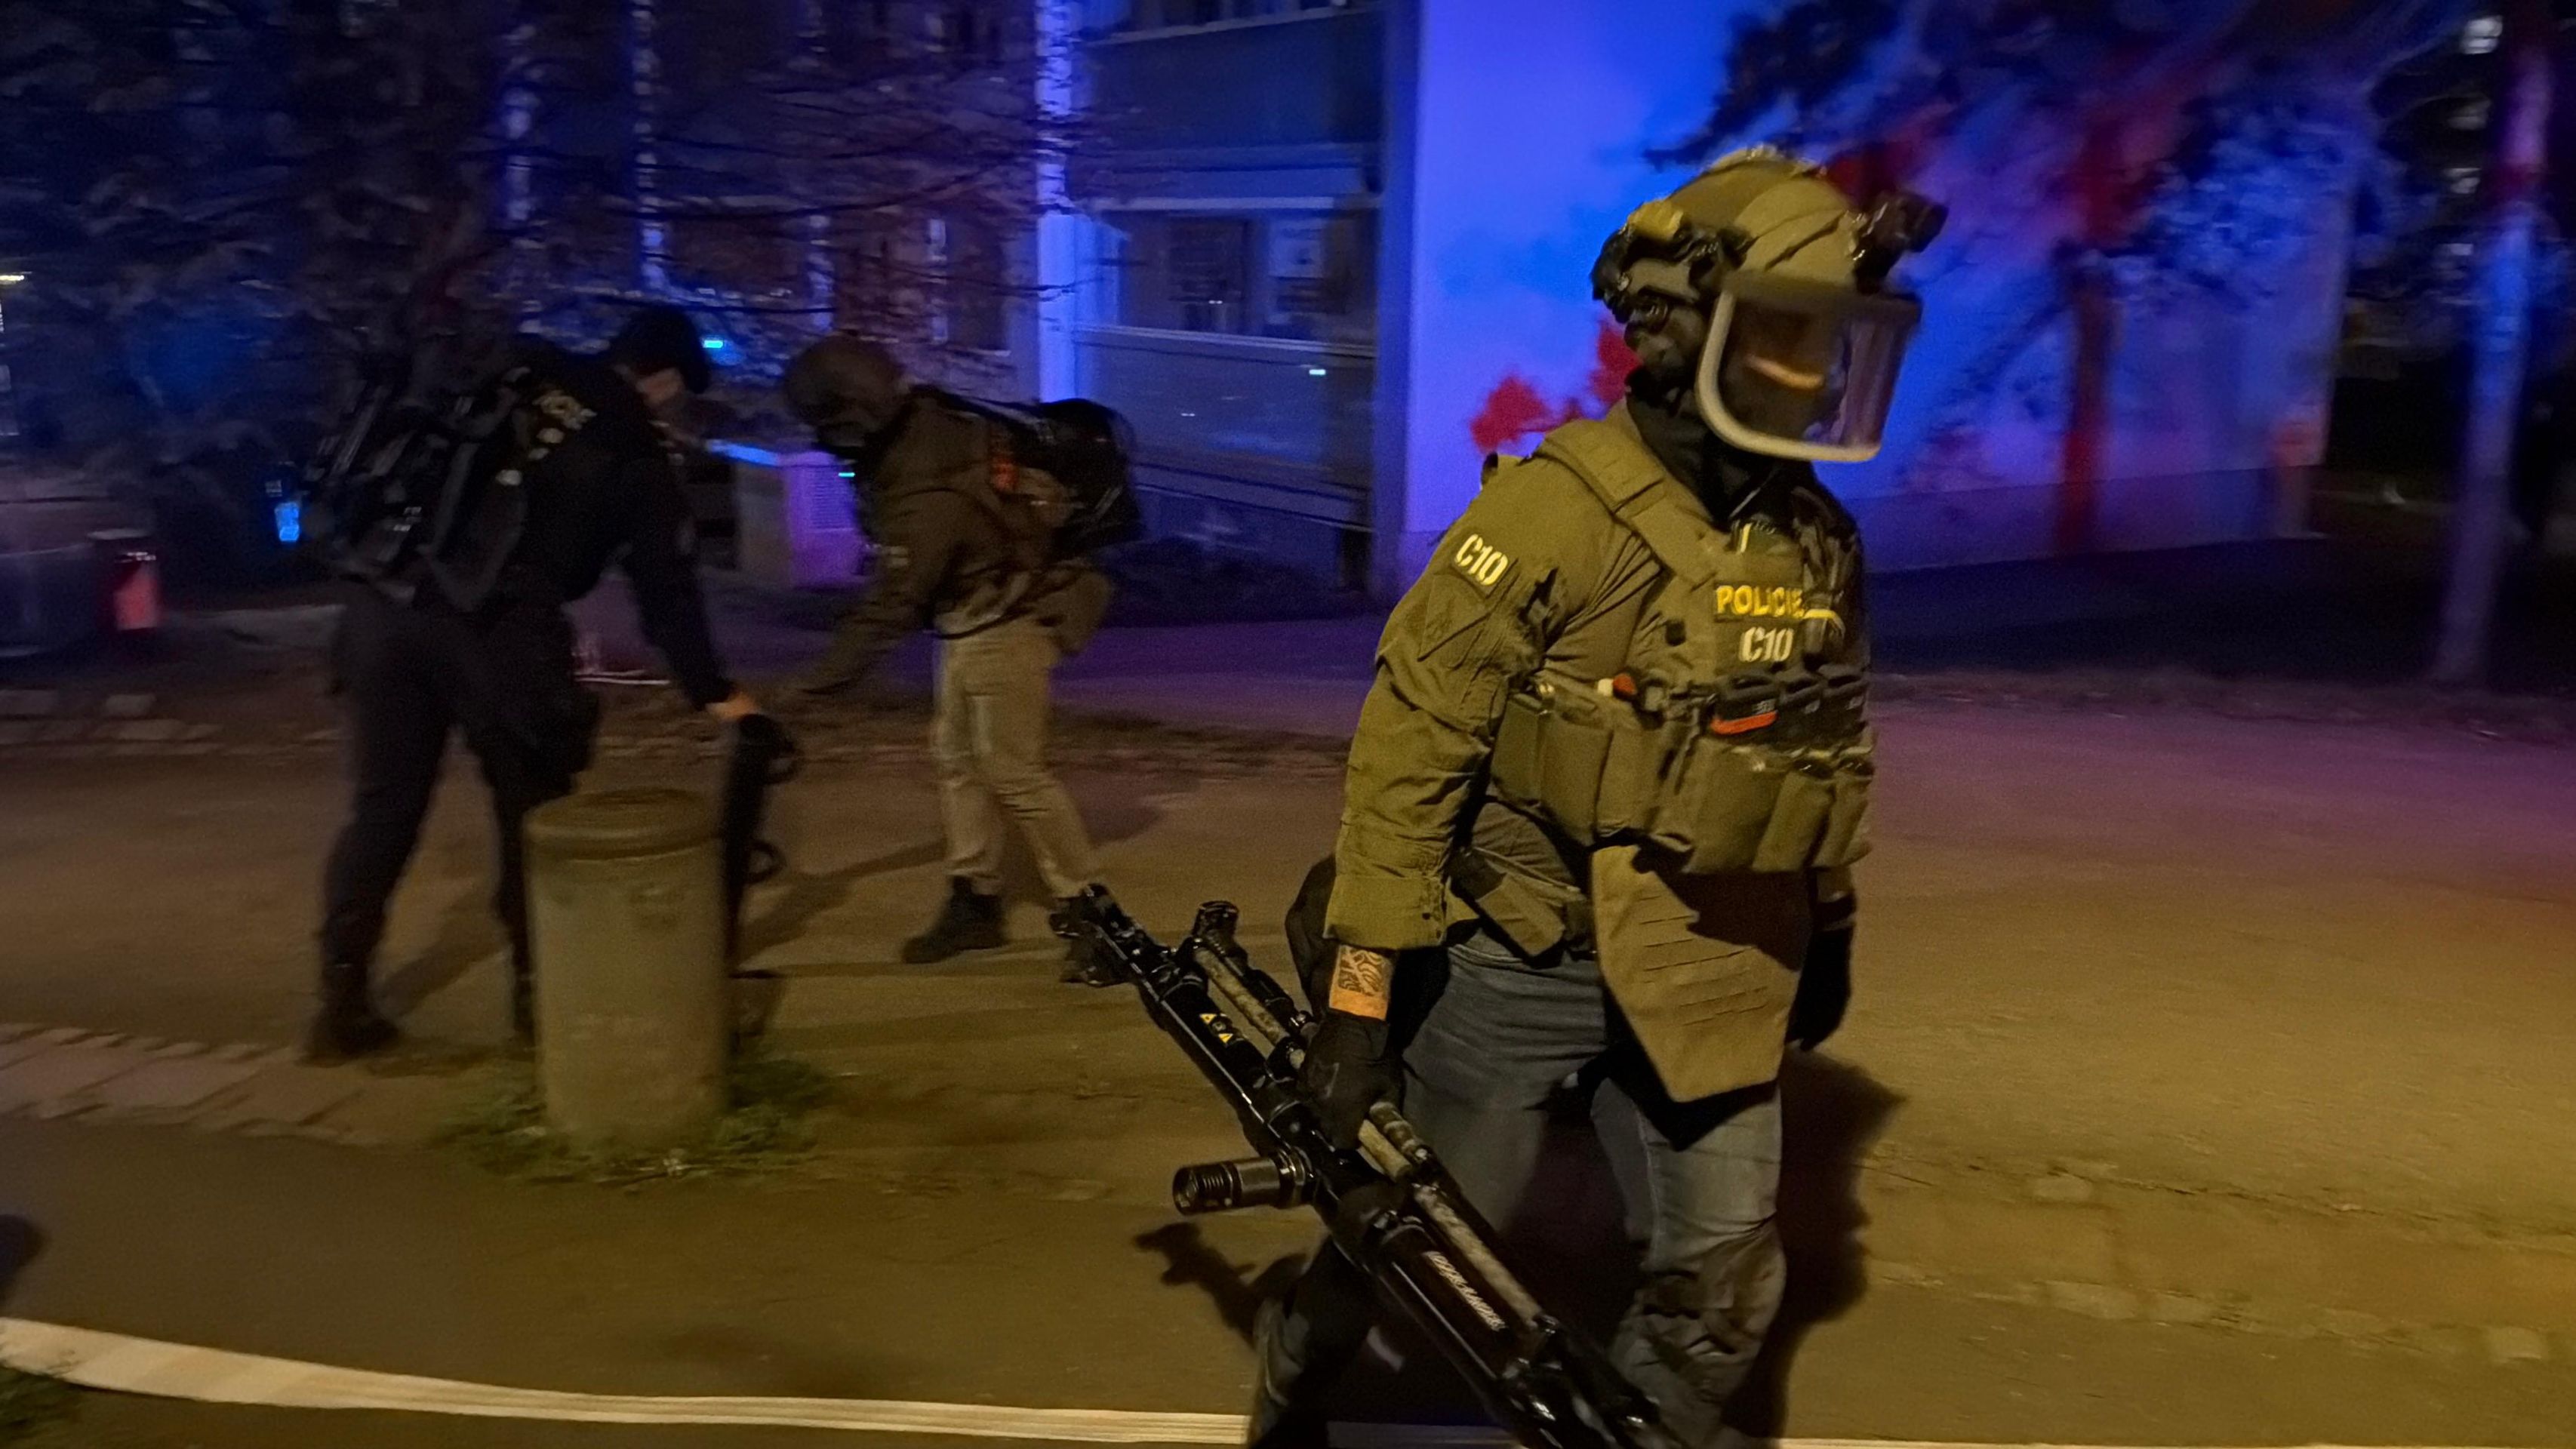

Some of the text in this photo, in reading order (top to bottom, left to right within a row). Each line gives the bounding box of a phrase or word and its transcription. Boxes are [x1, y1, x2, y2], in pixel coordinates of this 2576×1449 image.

[1455, 534, 1509, 586] C10
[1716, 585, 1805, 618] POLICIE
[1739, 626, 1794, 662] C10
